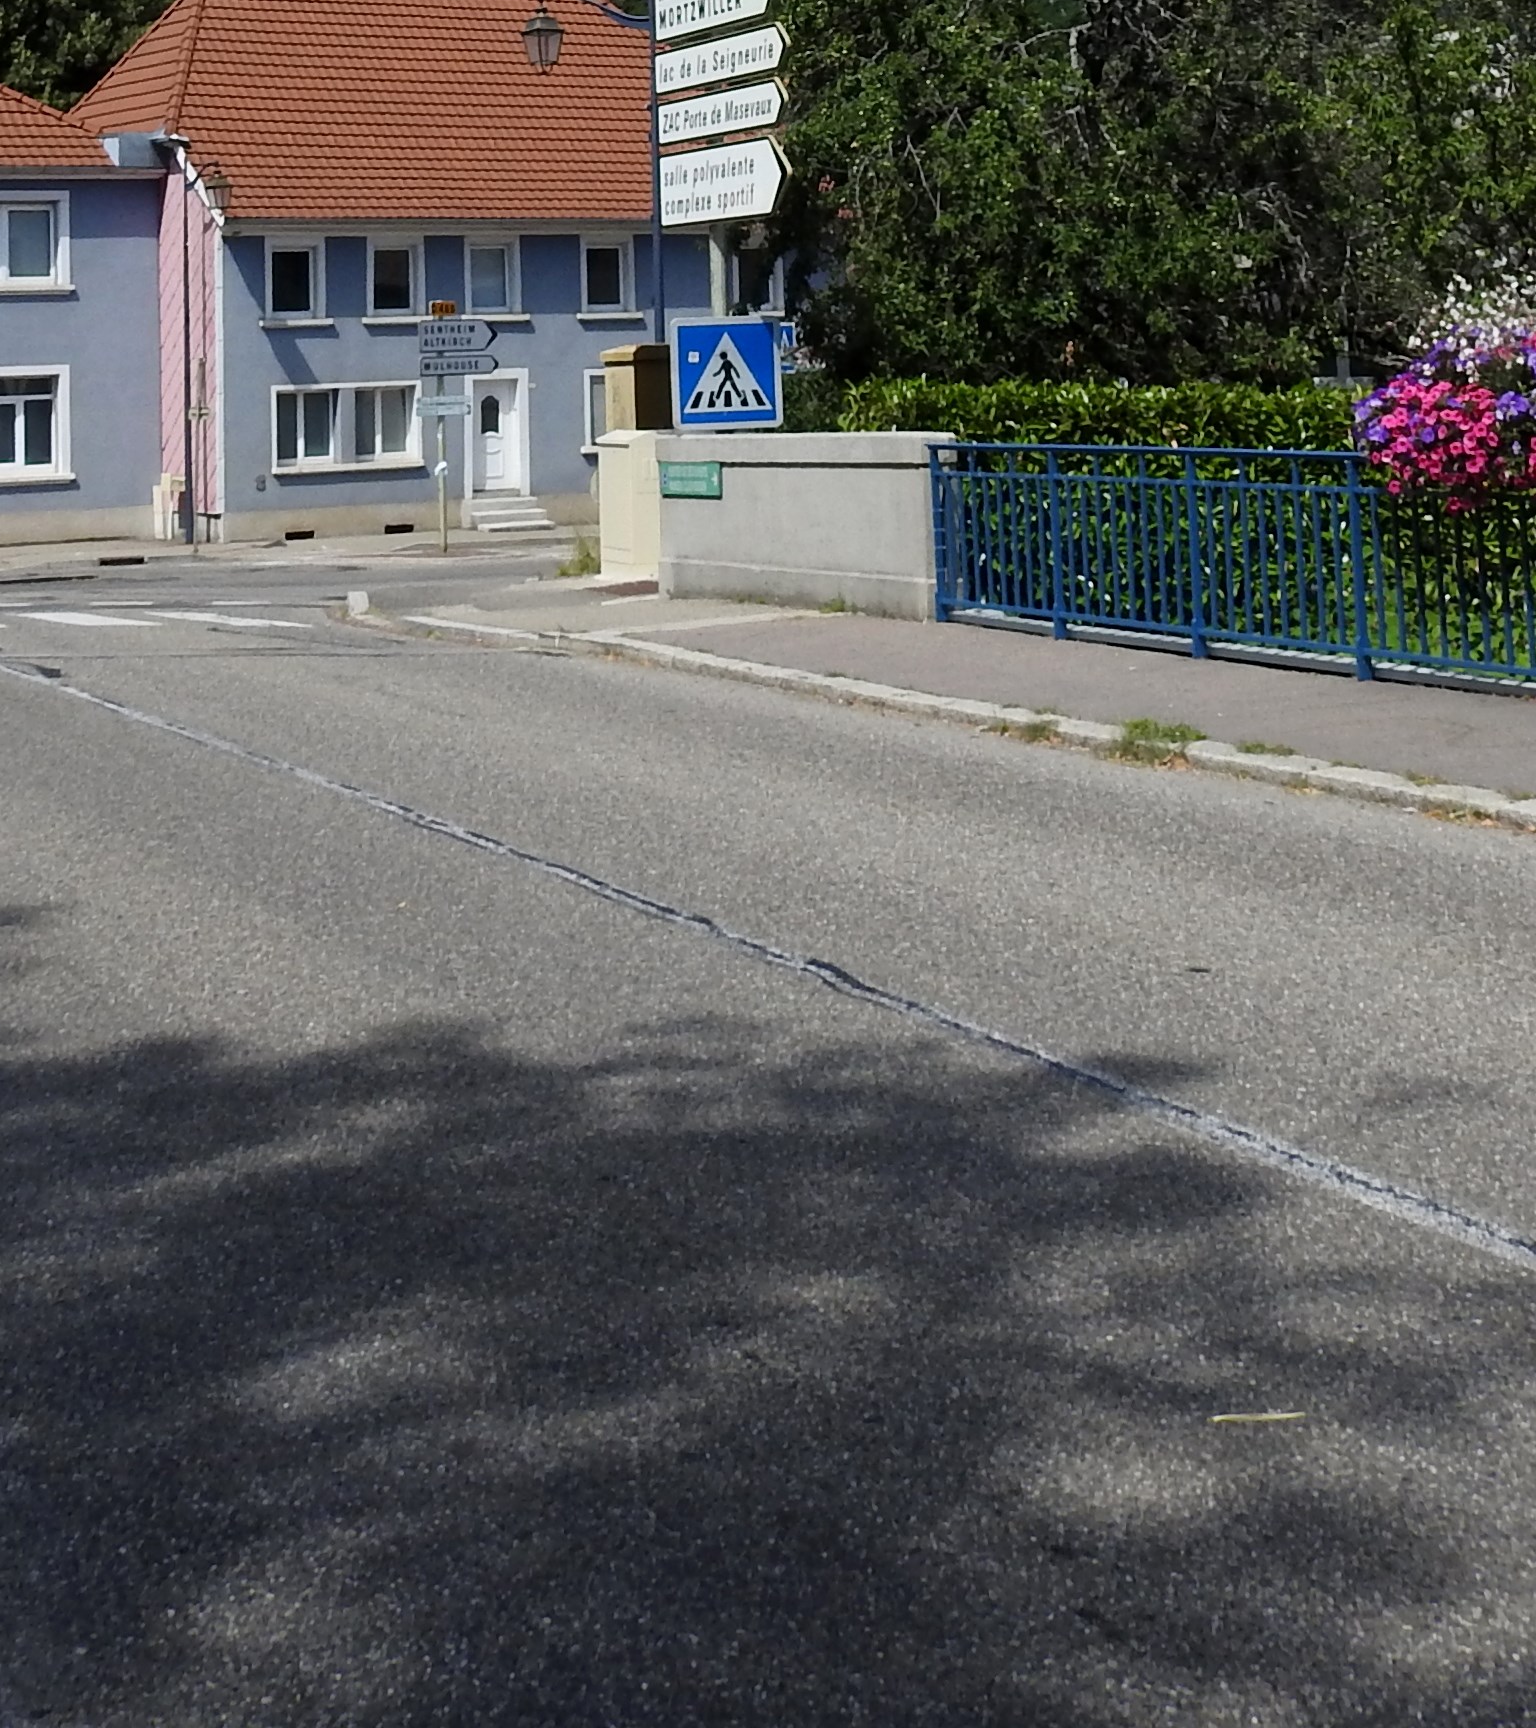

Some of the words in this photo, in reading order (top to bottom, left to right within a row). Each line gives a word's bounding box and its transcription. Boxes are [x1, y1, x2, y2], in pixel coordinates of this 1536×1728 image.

[660, 63, 674, 84] lac
[680, 58, 691, 78] de
[697, 54, 706, 75] la
[713, 38, 774, 73] Seigneurie
[663, 111, 680, 134] ZAC
[683, 109, 707, 130] Porte
[711, 104, 721, 125] de
[725, 98, 773, 122] Masevaux
[664, 165, 688, 187] salle
[693, 156, 754, 188] polyvalente
[665, 192, 711, 219] complexe
[717, 183, 754, 214] sportif
[424, 325, 475, 335] SENTHEIM
[424, 337, 472, 347] ALTKIRCH
[424, 360, 479, 371] MULHOUSE
